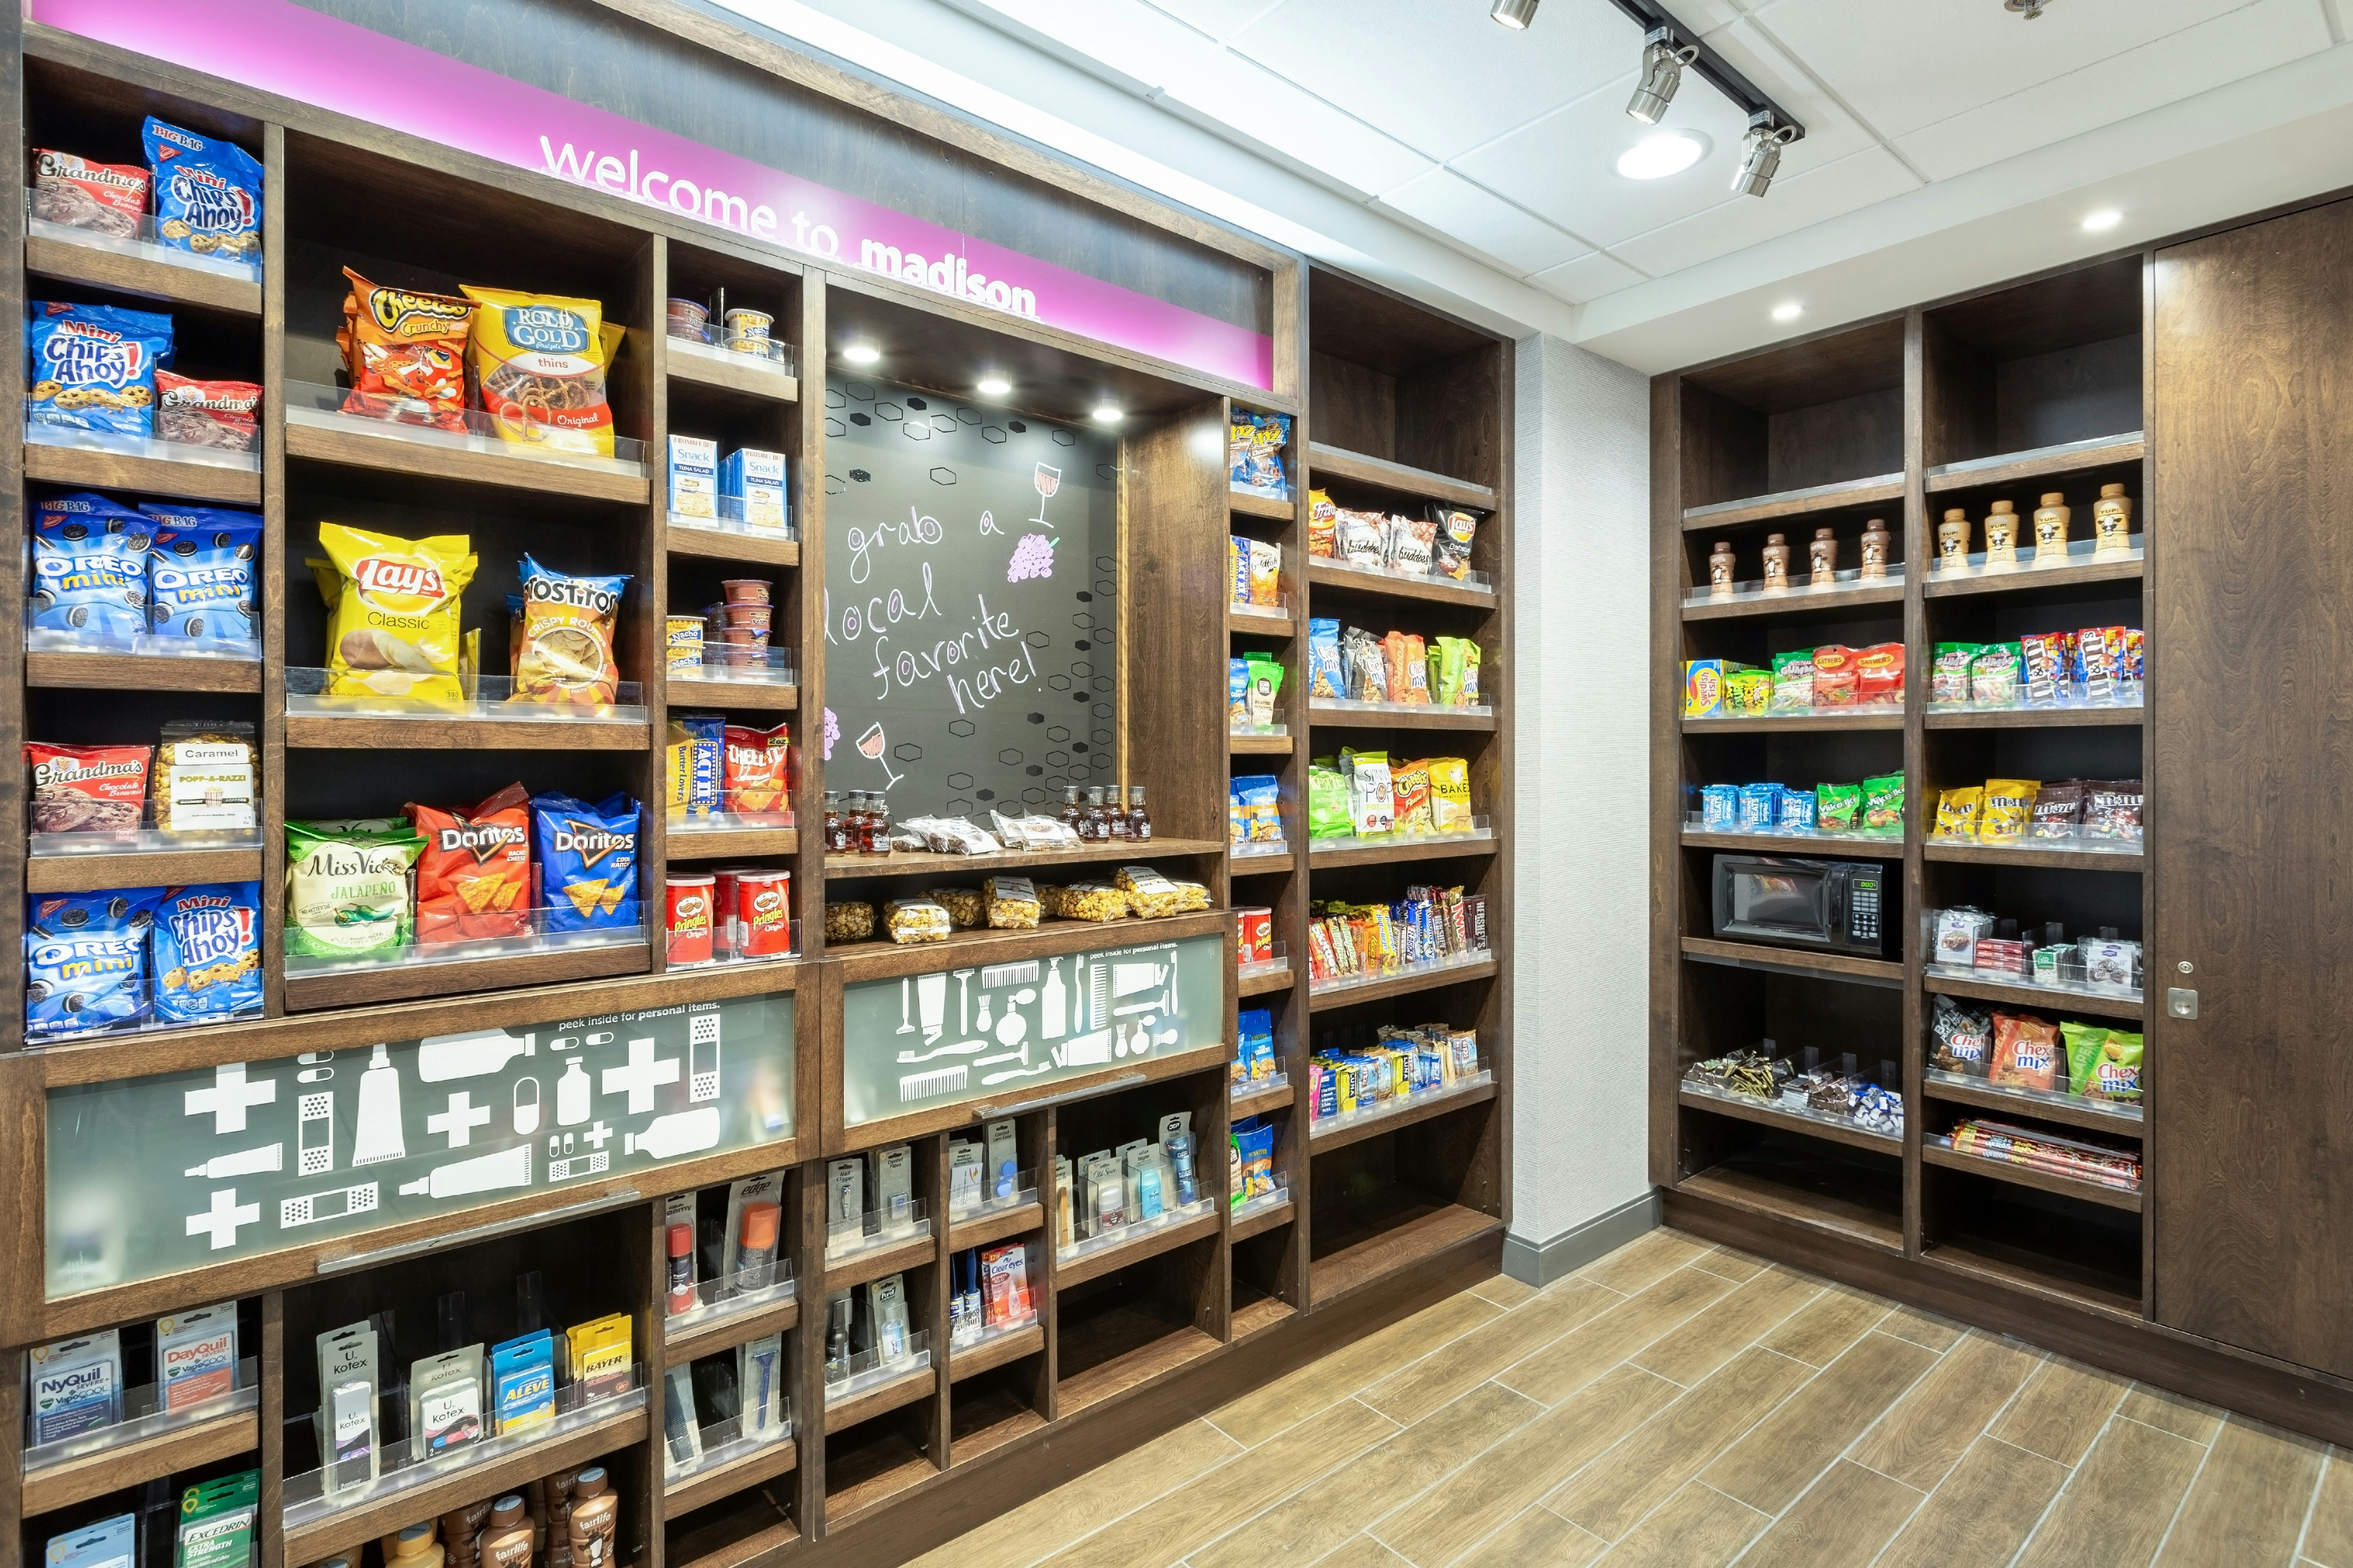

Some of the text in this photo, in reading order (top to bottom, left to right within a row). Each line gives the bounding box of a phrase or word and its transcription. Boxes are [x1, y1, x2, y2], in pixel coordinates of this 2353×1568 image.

[153, 125, 203, 151] BIG BAG
[175, 166, 225, 189] Mini
[104, 191, 141, 206] Chocolate
[174, 176, 237, 208] Chips
[187, 189, 254, 231] Ahoy!
[539, 136, 1036, 319] welcome to madison
[371, 290, 470, 328] Cheetos
[518, 309, 574, 328] ROLD
[62, 320, 122, 343] Mini
[401, 319, 448, 335] Crunchy
[747, 328, 769, 336] Nacho
[513, 326, 581, 350] GOLD
[536, 342, 561, 351] Pretzels
[47, 338, 123, 360] Chips
[56, 342, 139, 386] Ahoy!
[538, 358, 568, 368] thins
[162, 391, 258, 409] Grandma's
[35, 413, 44, 424] 150
[557, 412, 599, 426] Original
[678, 438, 701, 447] BUMBLE
[678, 449, 709, 462] Snack
[750, 462, 778, 474] Snack
[41, 502, 90, 512] BIG BAG
[149, 515, 197, 527] BIG BAG
[1452, 517, 1474, 532] Lay's
[848, 505, 1004, 584] grab a
[1449, 543, 1470, 553] Barbecue
[37, 556, 142, 576] OREO
[63, 572, 126, 591] mini
[154, 569, 248, 588] OREO
[362, 560, 439, 594] Lay's
[179, 583, 241, 603] mini
[529, 576, 618, 614] TOSTITOS
[824, 562, 941, 645] local
[367, 612, 429, 630] Classic
[528, 616, 607, 647] CRISPY ROUNDS
[672, 631, 698, 641] Nacho
[873, 594, 1019, 700] favorite
[1318, 647, 1337, 659] Chex
[672, 659, 697, 668] Nacho
[1325, 659, 1339, 671] mix
[1393, 640, 1405, 687] CHEDDAR
[1409, 663, 1425, 676] Chex
[1860, 656, 1891, 665] SATHERS
[1700, 671, 1710, 707] Swedish
[1709, 677, 1717, 702] Fish
[35, 760, 143, 786] Grandma's
[697, 748, 712, 779] ACT
[677, 746, 687, 801] Butter Lovers
[1397, 770, 1428, 796] Cheetos
[99, 782, 139, 792] Chocolate
[1440, 784, 1470, 794] BAKED
[1819, 802, 1841, 813] Mike
[1866, 794, 1891, 807] Mike
[1794, 798, 1802, 827] TREATS
[441, 826, 525, 851] Doritos
[554, 831, 634, 851] Doritos
[307, 853, 357, 877] Miss
[331, 881, 396, 899] JALAPEÑO
[178, 896, 230, 911] Mini
[308, 903, 332, 913] ARTIFICIAL
[171, 909, 236, 945] Chips
[674, 914, 706, 937] Pringles
[753, 908, 782, 931] Pringles
[1477, 902, 1486, 949] HERSHEY'S
[1375, 914, 1388, 950] Butterfinger
[35, 940, 139, 965] OREO
[1090, 952, 1104, 960] peek
[1133, 943, 1158, 955] personal
[62, 955, 133, 979] mini
[559, 1002, 720, 1031] peek inside for personal items.
[2013, 1041, 2052, 1056] Chex
[2017, 1055, 2051, 1070] mix
[2098, 1063, 2139, 1079] Chex
[2102, 1077, 2138, 1093] mix
[741, 1181, 772, 1195] edge
[992, 1259, 1023, 1274] Clear eyes
[881, 1288, 894, 1300] Purell
[168, 1337, 227, 1364] DayQuil
[345, 1351, 354, 1361] U
[182, 1354, 229, 1372] VapoCOOL
[586, 1355, 623, 1373] BAYER
[42, 1367, 101, 1393] NyQuil
[56, 1386, 107, 1403] VapoCOOL
[504, 1379, 549, 1403] ALEVE
[444, 1400, 452, 1410] U
[429, 1448, 434, 1456] 2
[188, 1518, 250, 1543] EXCEDRIN
[186, 1539, 233, 1559] STRENGTH
[187, 1539, 215, 1553] EXTRA
